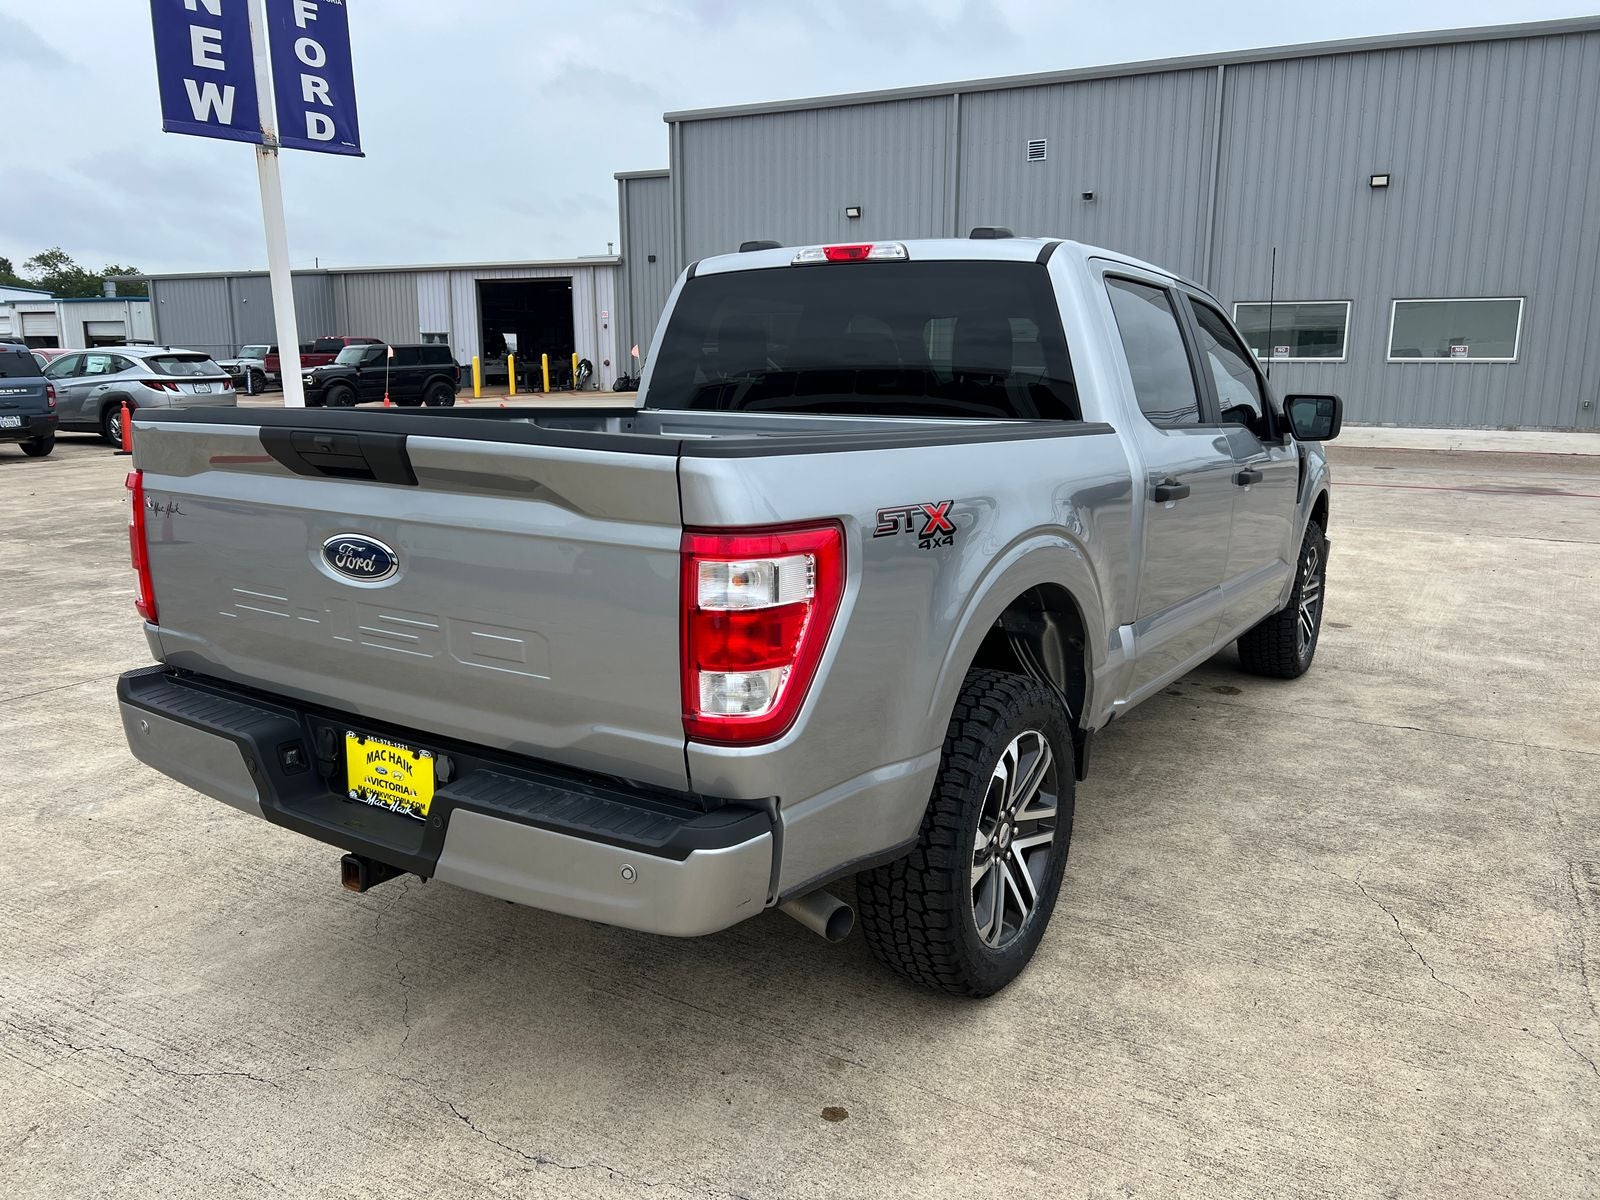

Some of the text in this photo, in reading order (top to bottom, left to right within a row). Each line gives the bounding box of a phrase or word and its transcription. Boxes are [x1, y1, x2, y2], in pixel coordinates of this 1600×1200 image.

[183, 0, 235, 125] EW
[293, 0, 336, 141] FORD
[873, 500, 957, 540] STX
[335, 543, 376, 572] Ford
[366, 750, 413, 777] MAC HAIK
[370, 777, 410, 796] VICTORIA
